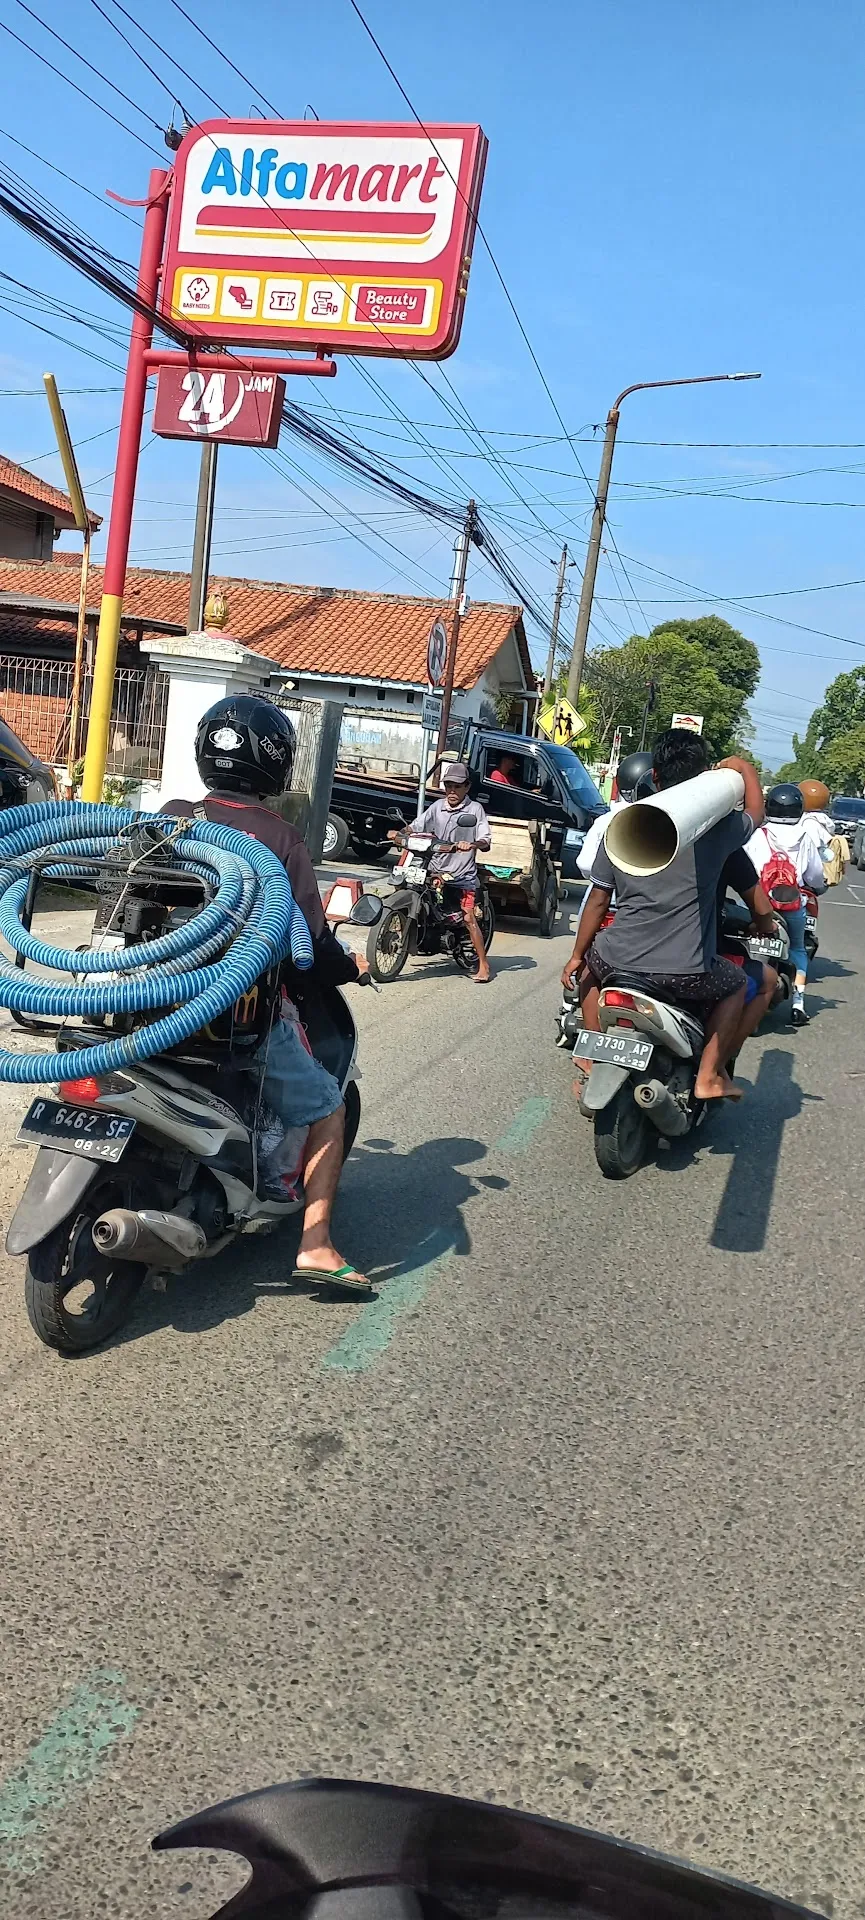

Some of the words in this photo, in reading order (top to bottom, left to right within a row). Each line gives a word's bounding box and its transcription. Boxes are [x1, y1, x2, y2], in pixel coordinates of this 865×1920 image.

[202, 147, 445, 204] Alfamart
[366, 290, 417, 310] Beauty
[369, 305, 408, 320] Store
[178, 371, 226, 423] 24
[245, 376, 273, 393] JAM
[580, 1032, 589, 1044] R
[595, 1035, 626, 1051] 3730
[631, 1044, 649, 1056] AP
[31, 1102, 46, 1120] R
[55, 1108, 98, 1133] 6462
[105, 1119, 130, 1139] SF
